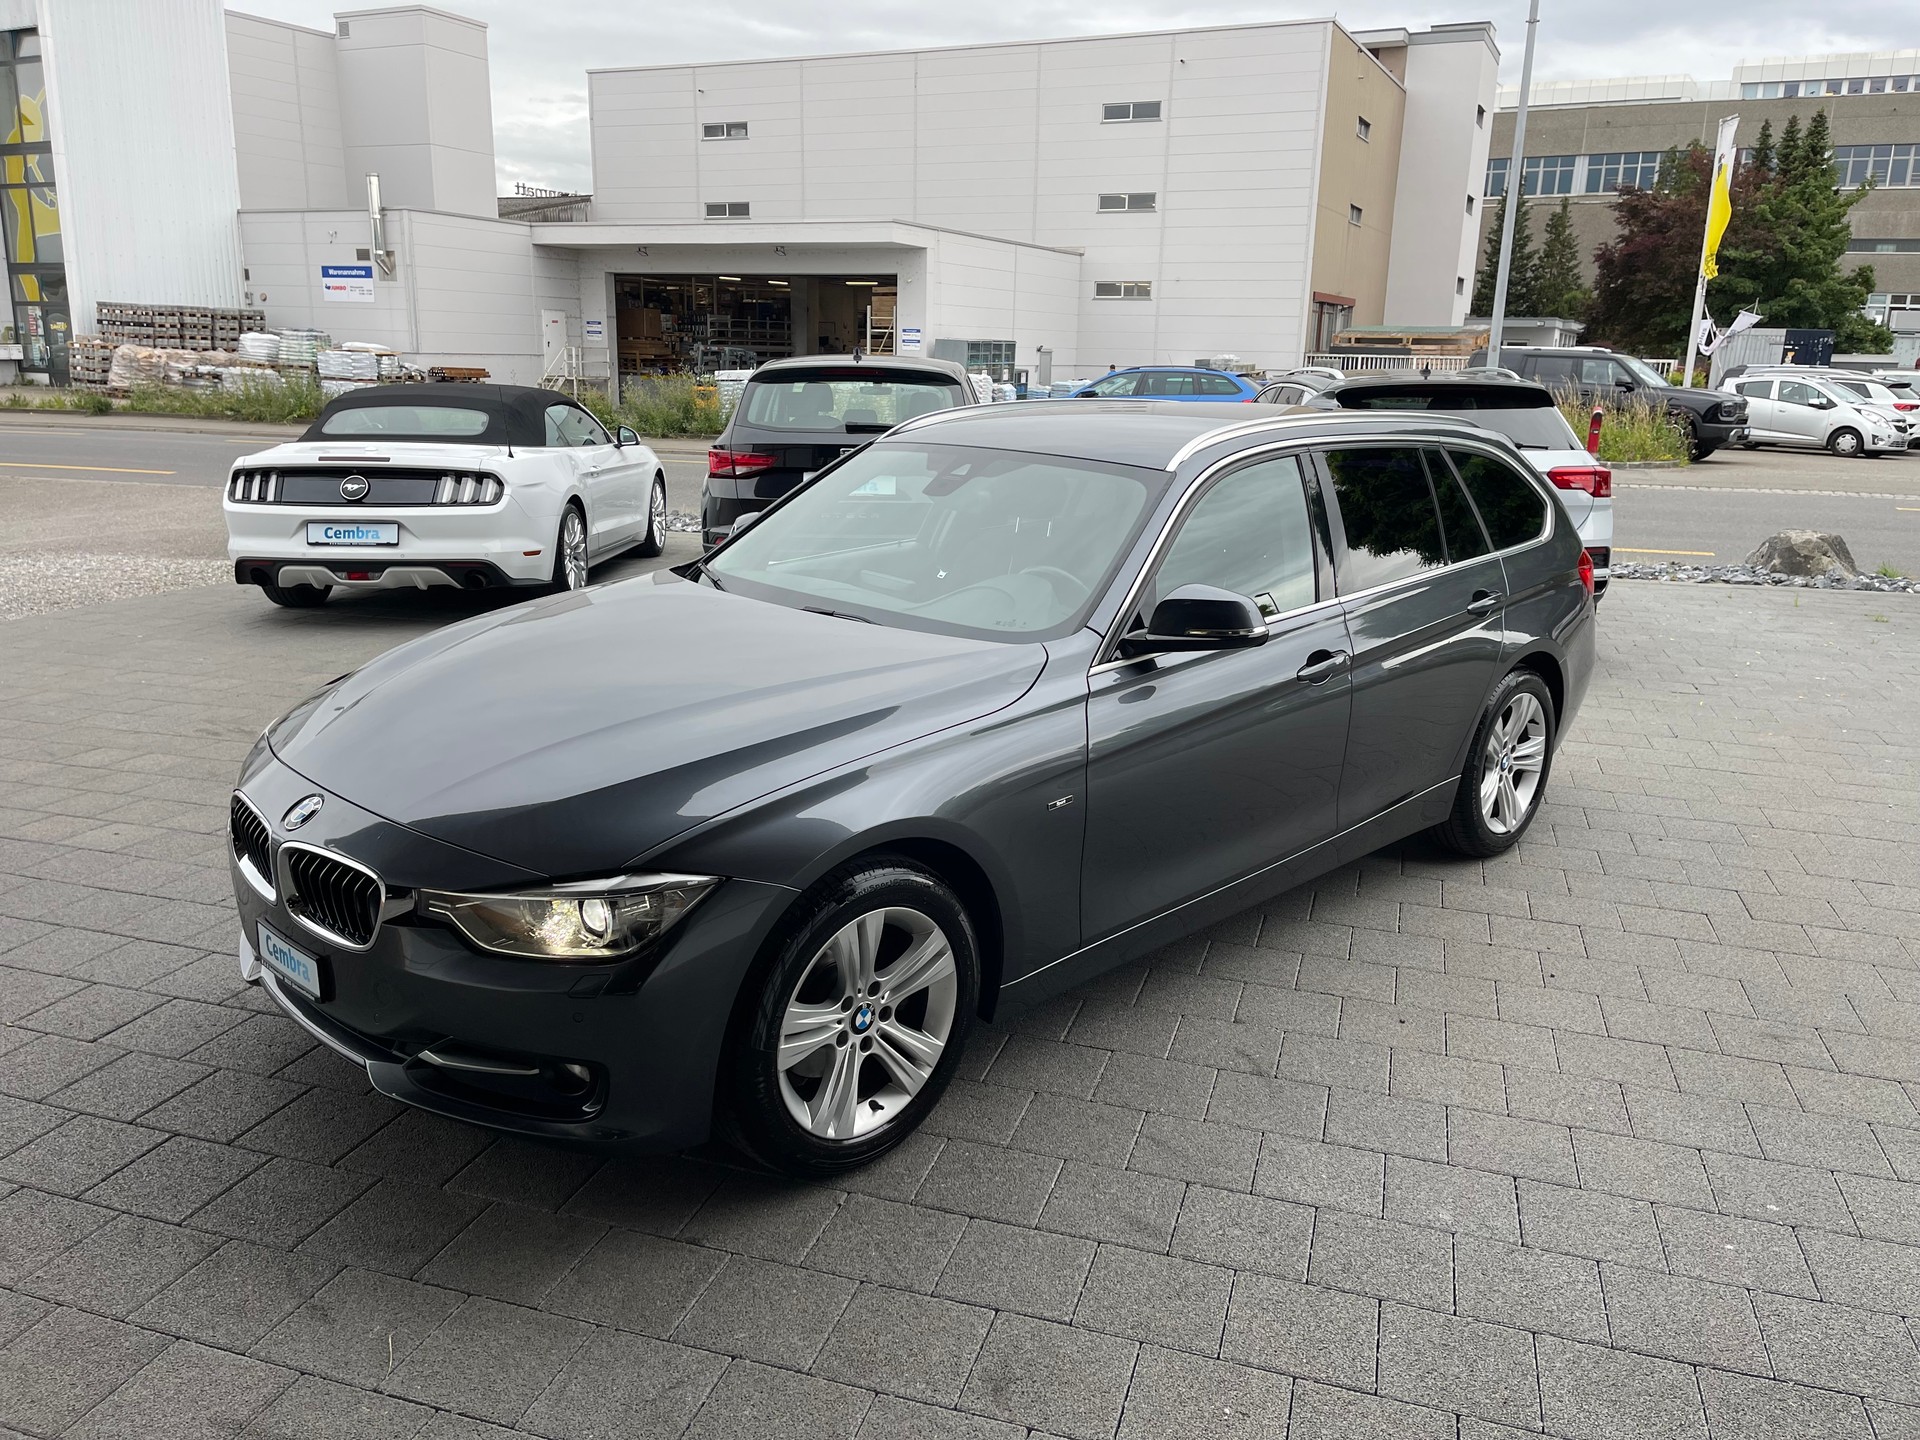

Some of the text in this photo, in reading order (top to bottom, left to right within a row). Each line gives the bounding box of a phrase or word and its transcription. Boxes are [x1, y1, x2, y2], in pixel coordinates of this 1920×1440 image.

[328, 268, 366, 276] Warenannahme
[324, 526, 380, 539] Cembra
[266, 934, 310, 982] Cembra
